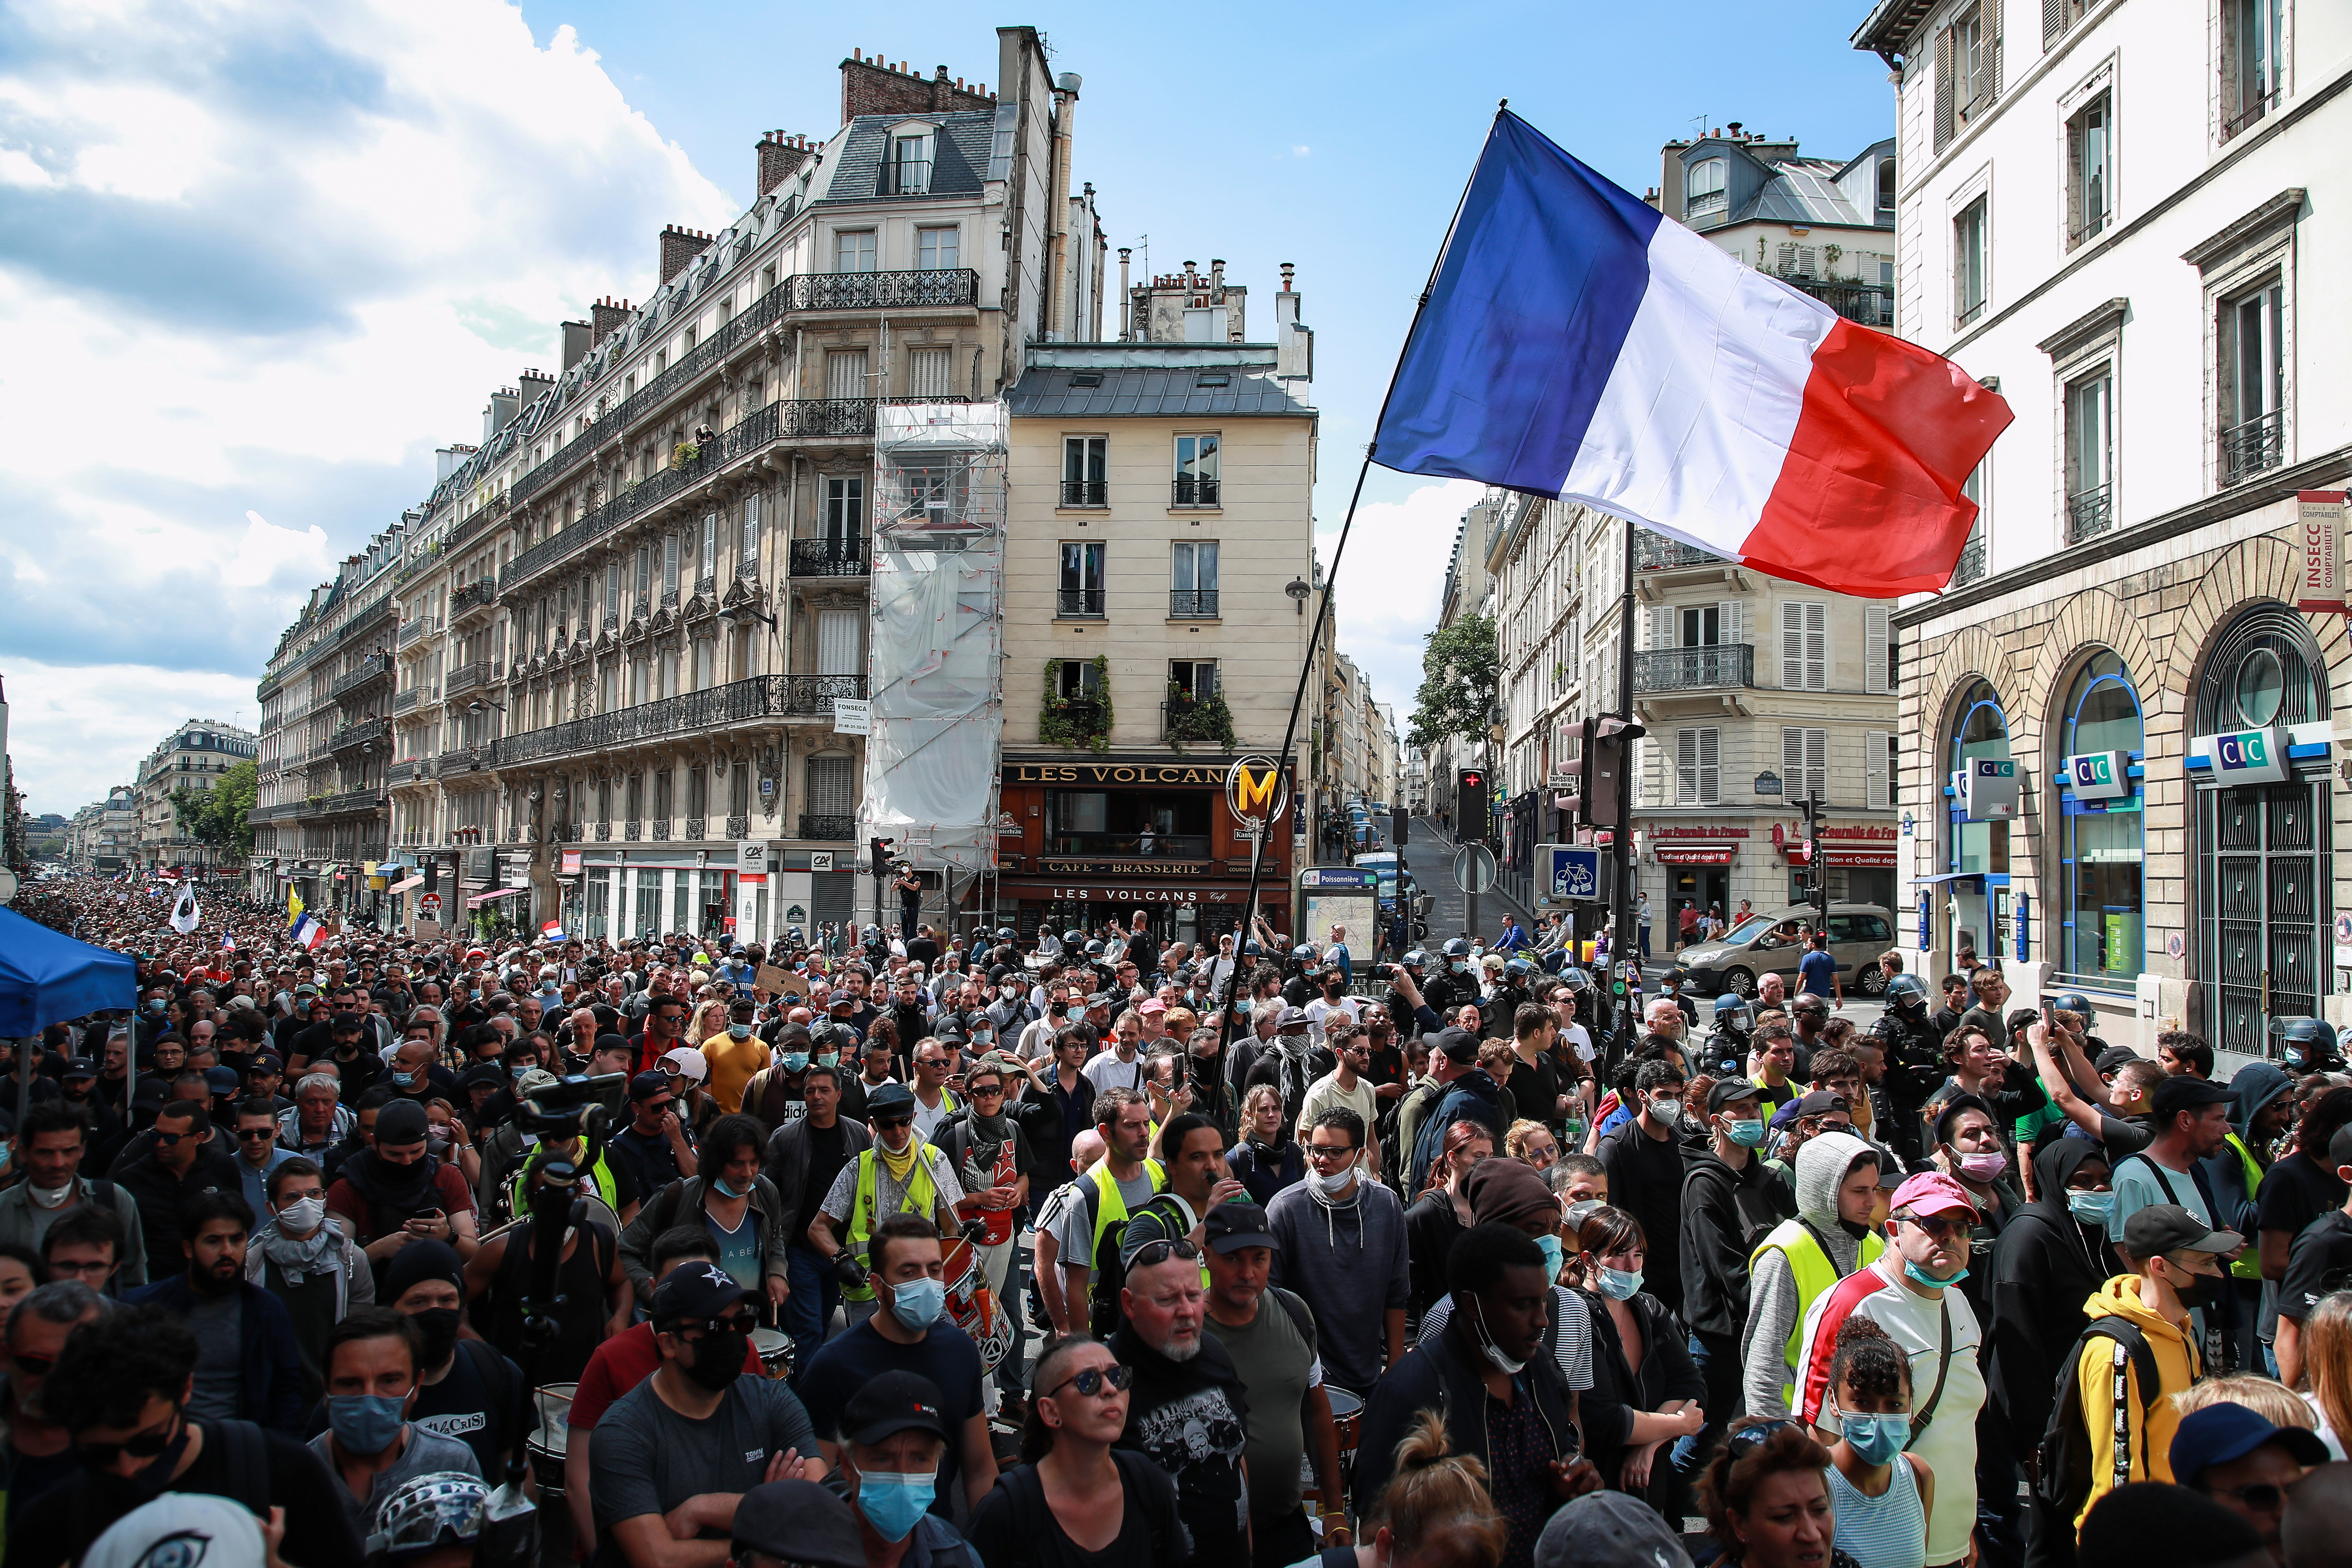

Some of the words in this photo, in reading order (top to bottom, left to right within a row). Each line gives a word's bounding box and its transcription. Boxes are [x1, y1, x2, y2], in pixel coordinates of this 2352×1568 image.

[2306, 524, 2321, 589] INSECC
[2322, 524, 2332, 589] COMPTABILITÉ
[2223, 739, 2262, 763] CIC
[1017, 767, 1077, 781] LES
[1091, 768, 1240, 783] VOLCAN
[1982, 764, 2010, 774] CIC
[2079, 760, 2107, 781] CIC
[1239, 765, 1277, 811] M
[1674, 826, 1707, 836] Fournils
[1708, 825, 1719, 836] de
[1720, 827, 1749, 836] France
[1823, 825, 1866, 837] Fournils
[1867, 826, 1880, 838] de
[1882, 827, 1897, 838] Fra
[1701, 853, 1715, 861] depuis
[1112, 864, 1200, 874] BRASSERIE
[1054, 889, 1088, 899] LES
[1106, 890, 1197, 901] VOLCANS
[733, 982, 752, 991] LNDO
[756, 976, 772, 988] PASS
[784, 1105, 808, 1119] dida
[739, 1242, 762, 1257] BEC
[745, 1447, 763, 1458] TOMM
